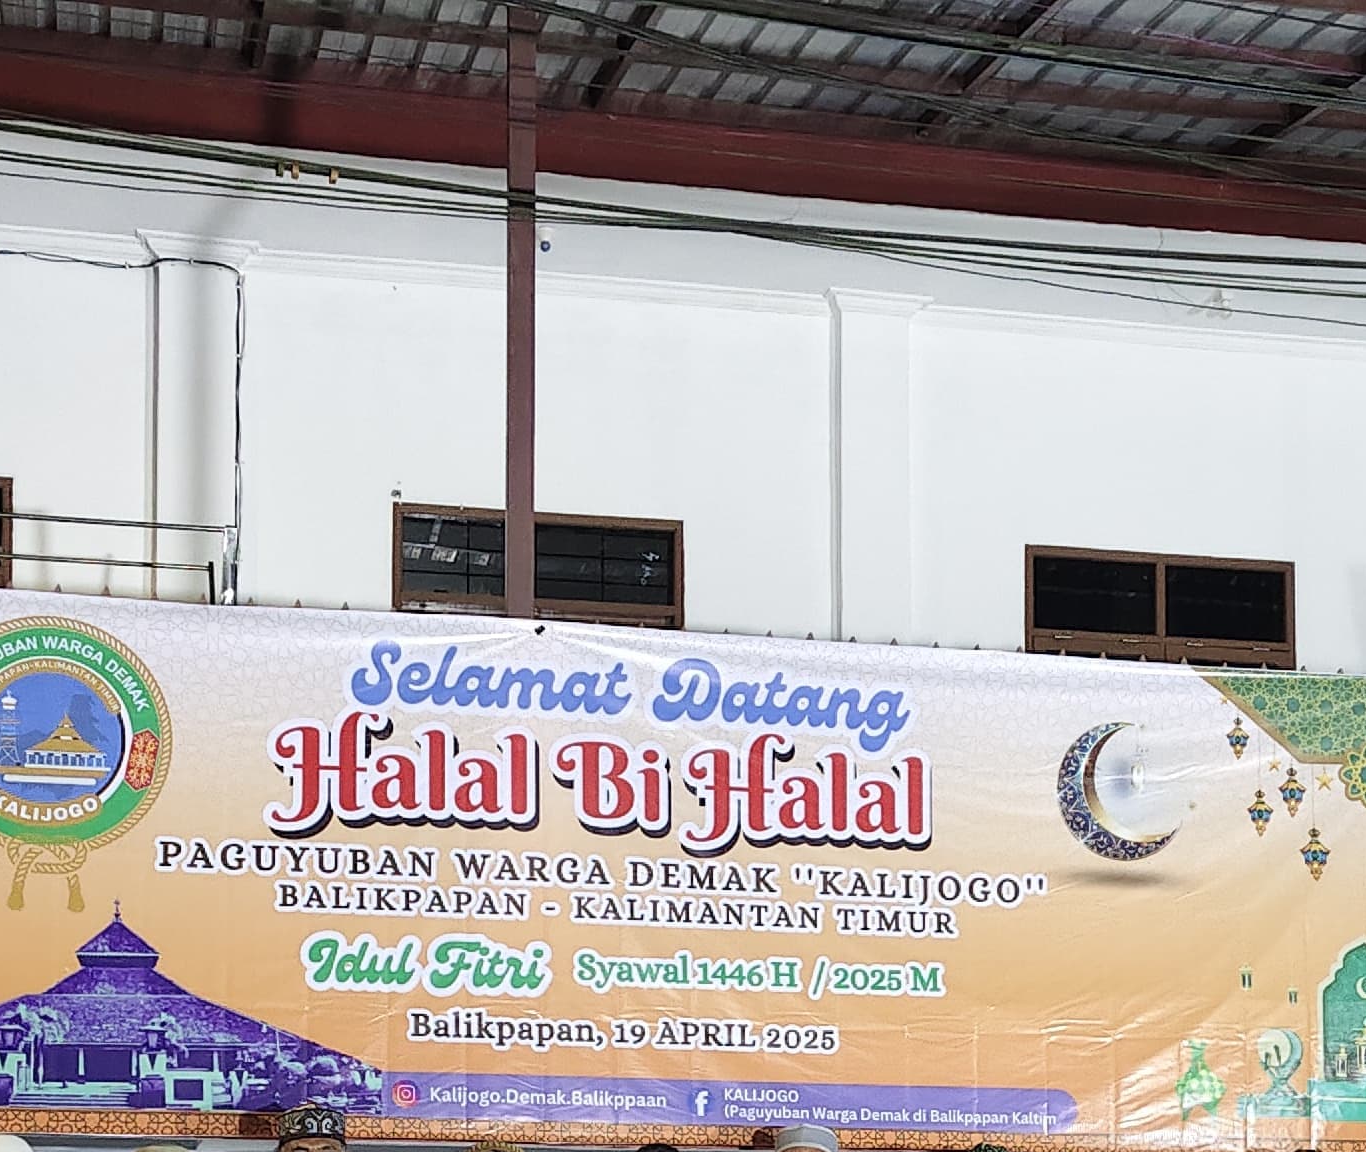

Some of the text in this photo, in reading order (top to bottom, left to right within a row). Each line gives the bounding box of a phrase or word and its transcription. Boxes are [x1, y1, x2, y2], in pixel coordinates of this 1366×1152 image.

[42, 635, 104, 668] WARGA
[104, 658, 150, 712] DEMAK
[352, 640, 911, 753] Selamat Datang
[271, 711, 926, 842] Halal Bi Halal
[158, 841, 436, 877] PAGUYUBAN
[455, 853, 611, 886] WARGA
[630, 860, 778, 893] DEMAK
[278, 884, 527, 916] BALIKPAPAN
[572, 896, 820, 929] KALIMANTAN
[836, 908, 956, 935] TIMUR
[308, 938, 546, 989] Idul Fitri
[577, 953, 943, 995] Syawal 1446 H / 2025 M
[410, 1013, 837, 1051] Balikpapan, 19 APRIL 2025
[429, 1086, 667, 1111] Kalijogo.Demak.Balikppaan
[723, 1088, 800, 1103] KALIJOGO
[723, 1103, 1058, 1128] (Paguyuban Warga Demak di Balikpapan Kaltim
